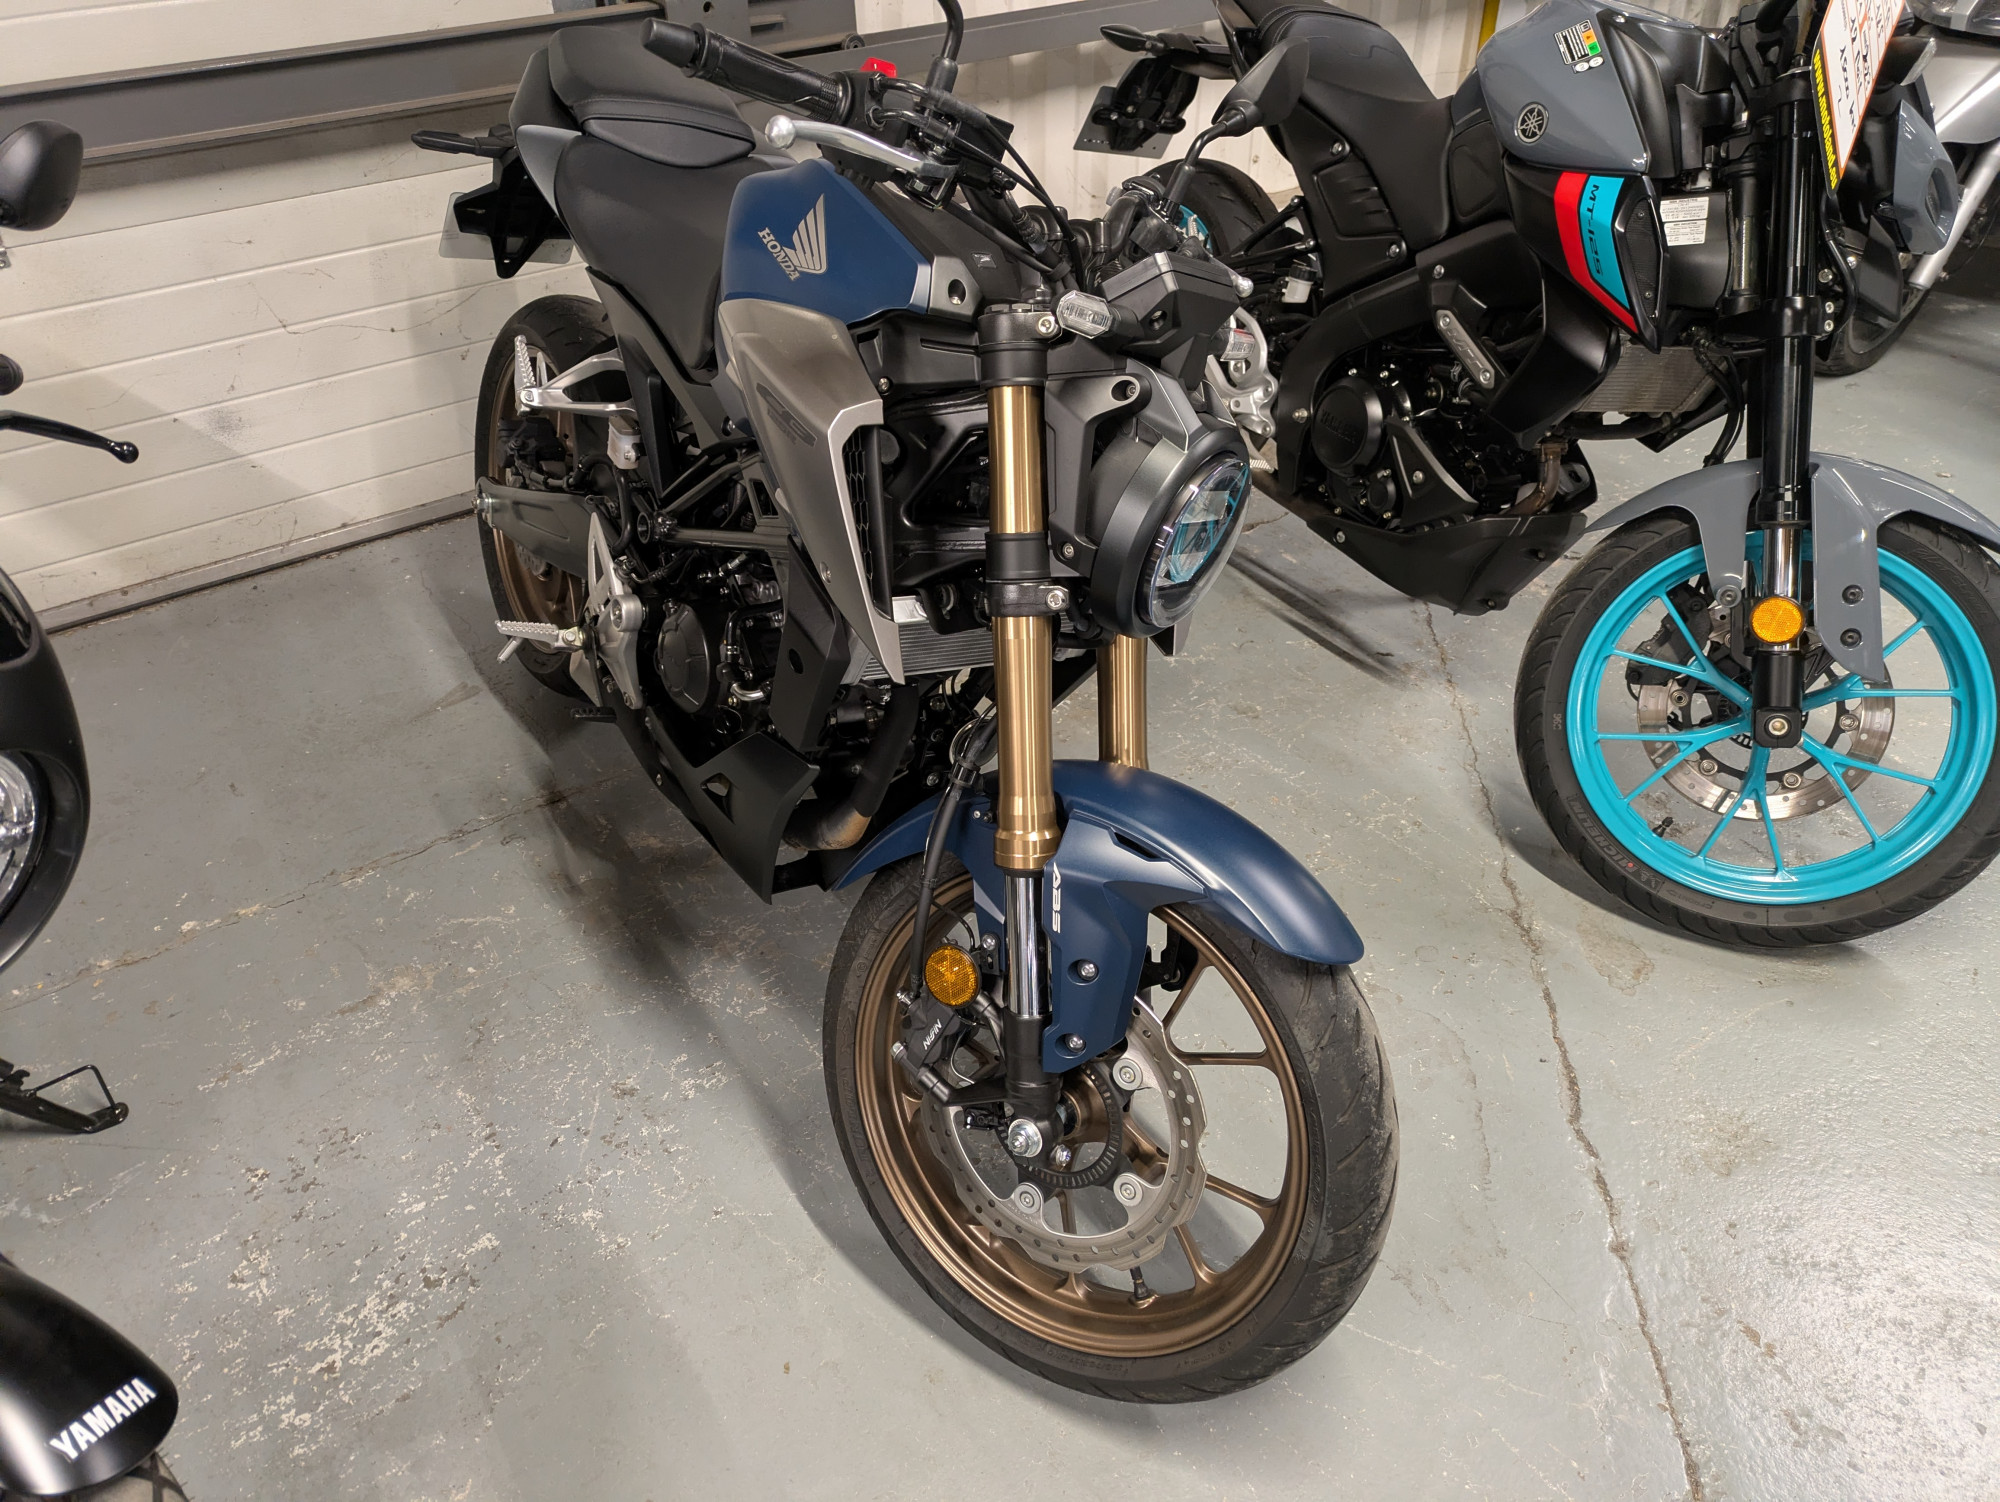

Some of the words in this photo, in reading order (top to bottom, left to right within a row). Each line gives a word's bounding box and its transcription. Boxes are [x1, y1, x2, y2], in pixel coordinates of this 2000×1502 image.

[1813, 48, 1838, 190] www.motoland.eu
[757, 227, 800, 281] HONDA
[1586, 184, 1604, 276] MT-125
[1566, 798, 1638, 874] MICHELIN
[1052, 861, 1062, 934] ABS
[922, 1018, 942, 1050] NISSIN
[48, 1377, 157, 1460] YAMAHA
